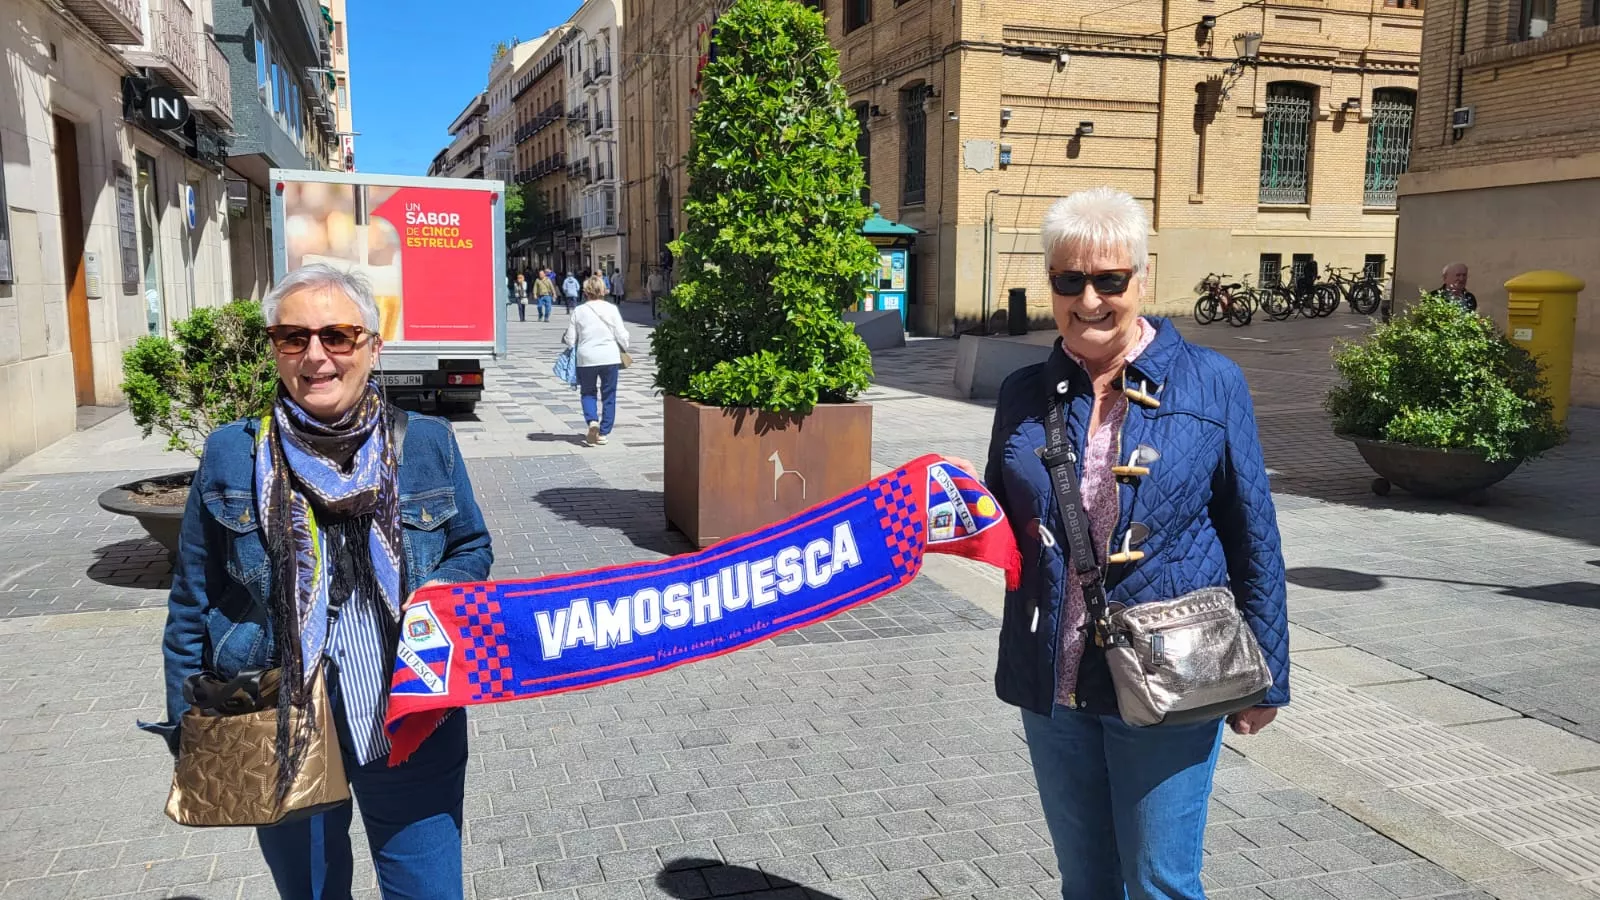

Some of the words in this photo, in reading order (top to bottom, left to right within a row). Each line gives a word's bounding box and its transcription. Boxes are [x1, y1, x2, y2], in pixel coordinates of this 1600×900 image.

[150, 96, 180, 121] IN
[405, 202, 421, 211] UN
[405, 211, 460, 226] SABOR
[406, 227, 419, 236] DE
[422, 226, 460, 237] CINCO
[406, 237, 473, 249] ESTRELLAS
[403, 375, 421, 385] JRM
[935, 469, 964, 508] HUESCA
[1065, 503, 1085, 549] ROBERT
[535, 520, 863, 661] VAMOSHUESCA
[400, 646, 438, 689] HUESCA
